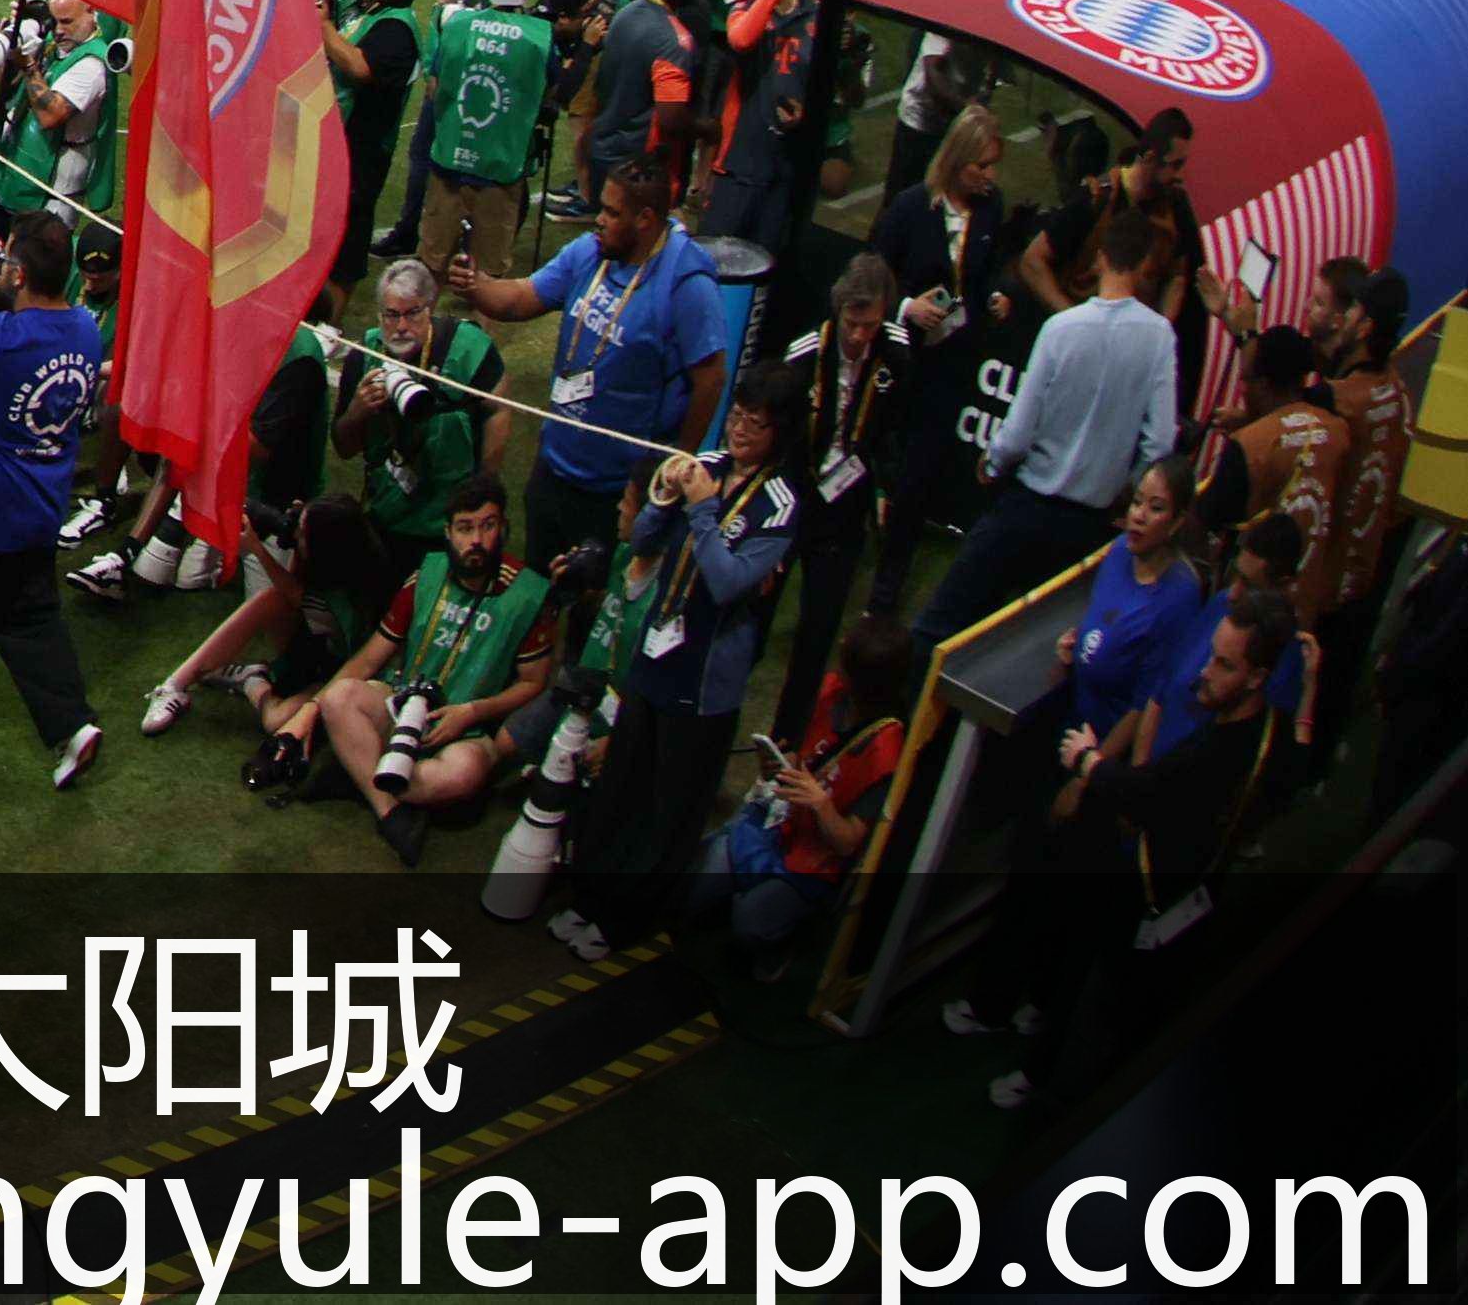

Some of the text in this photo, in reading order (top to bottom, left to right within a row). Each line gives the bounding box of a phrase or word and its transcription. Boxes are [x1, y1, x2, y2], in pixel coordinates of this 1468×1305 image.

[470, 19, 523, 40] PHOTO
[1032, 5, 1079, 37] FC
[775, 37, 799, 74] T
[1118, 13, 1256, 90] MÜNCHEN
[8, 381, 33, 423] CLUB
[34, 353, 84, 381] WORLD
[978, 358, 1018, 402] CL
